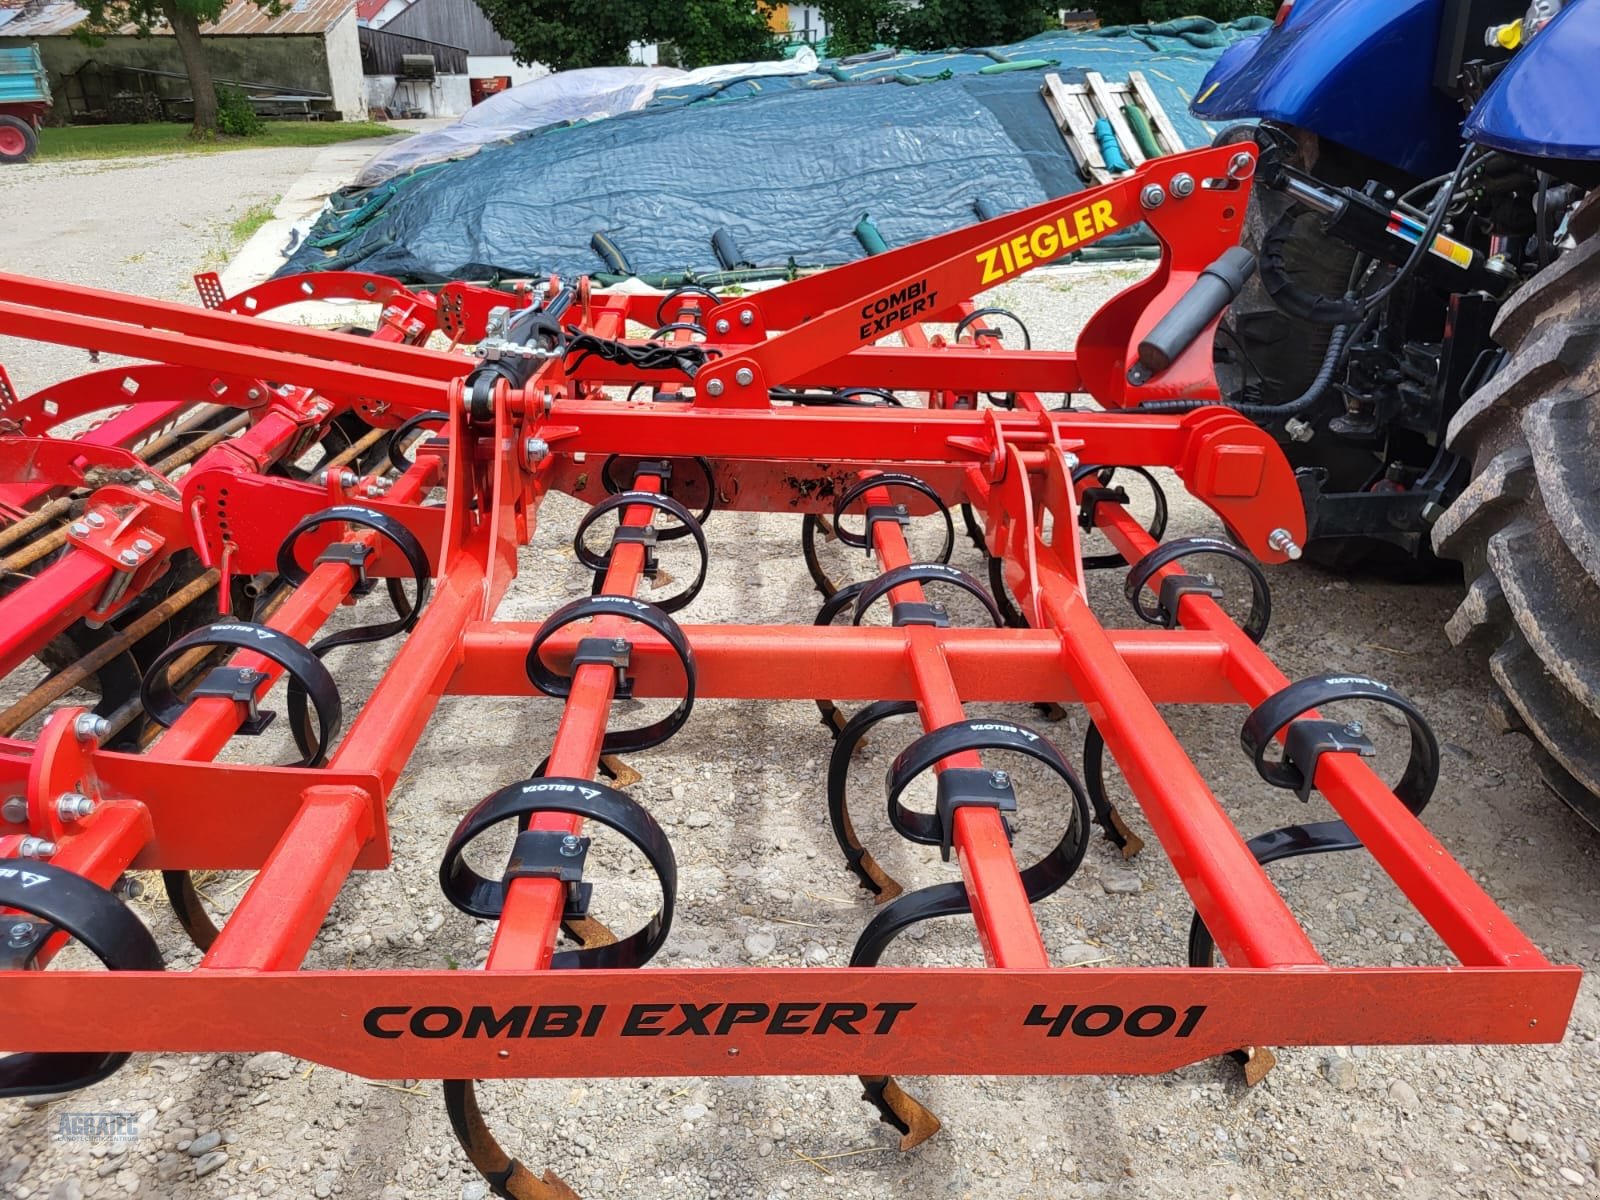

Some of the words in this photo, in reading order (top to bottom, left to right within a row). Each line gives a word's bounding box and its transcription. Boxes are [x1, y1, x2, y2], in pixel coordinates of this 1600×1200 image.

[976, 199, 1118, 285] ZIEGLER
[860, 291, 938, 340] EXPERT
[861, 279, 927, 319] COMBI
[969, 724, 1018, 735] BELLOTA
[521, 783, 576, 795] BELLOTA
[363, 1004, 607, 1039] COMBI
[620, 1003, 917, 1036] EXPERT
[1023, 1005, 1207, 1037] 4001
